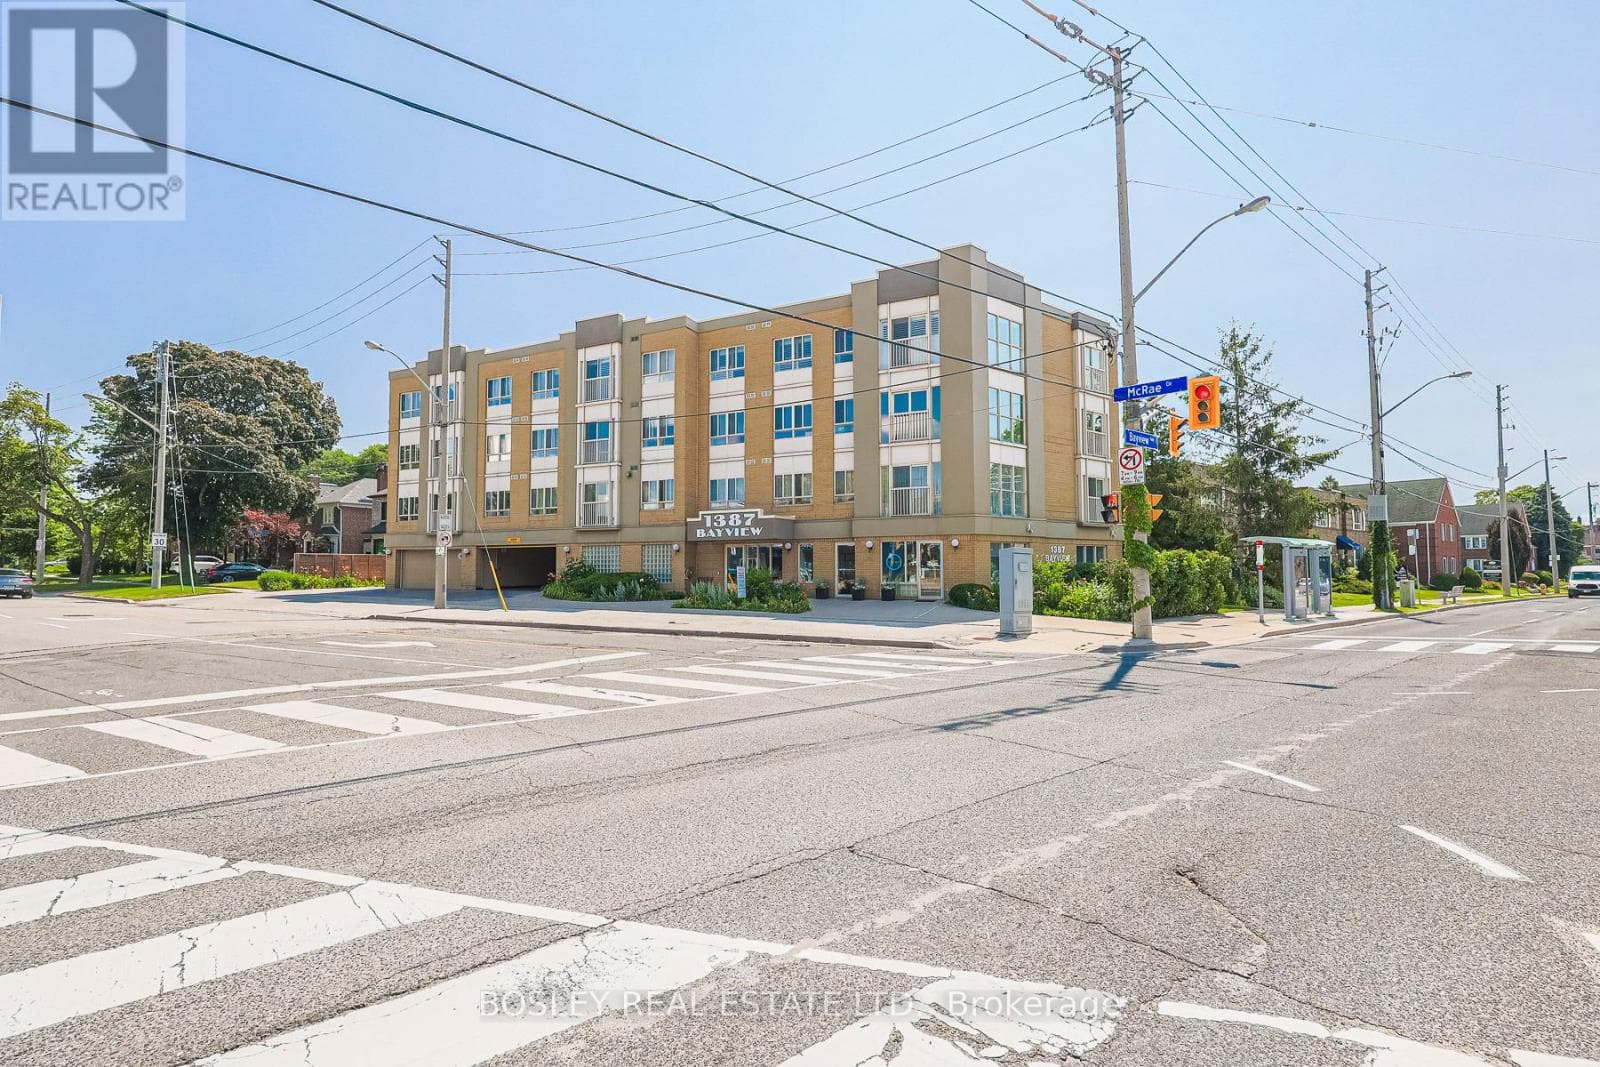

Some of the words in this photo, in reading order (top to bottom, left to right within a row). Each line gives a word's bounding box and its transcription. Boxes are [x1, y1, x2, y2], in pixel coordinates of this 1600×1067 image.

[1127, 384, 1162, 398] McRae
[704, 513, 756, 527] 1387
[696, 527, 763, 538] BAYVIEW
[154, 538, 165, 546] 30
